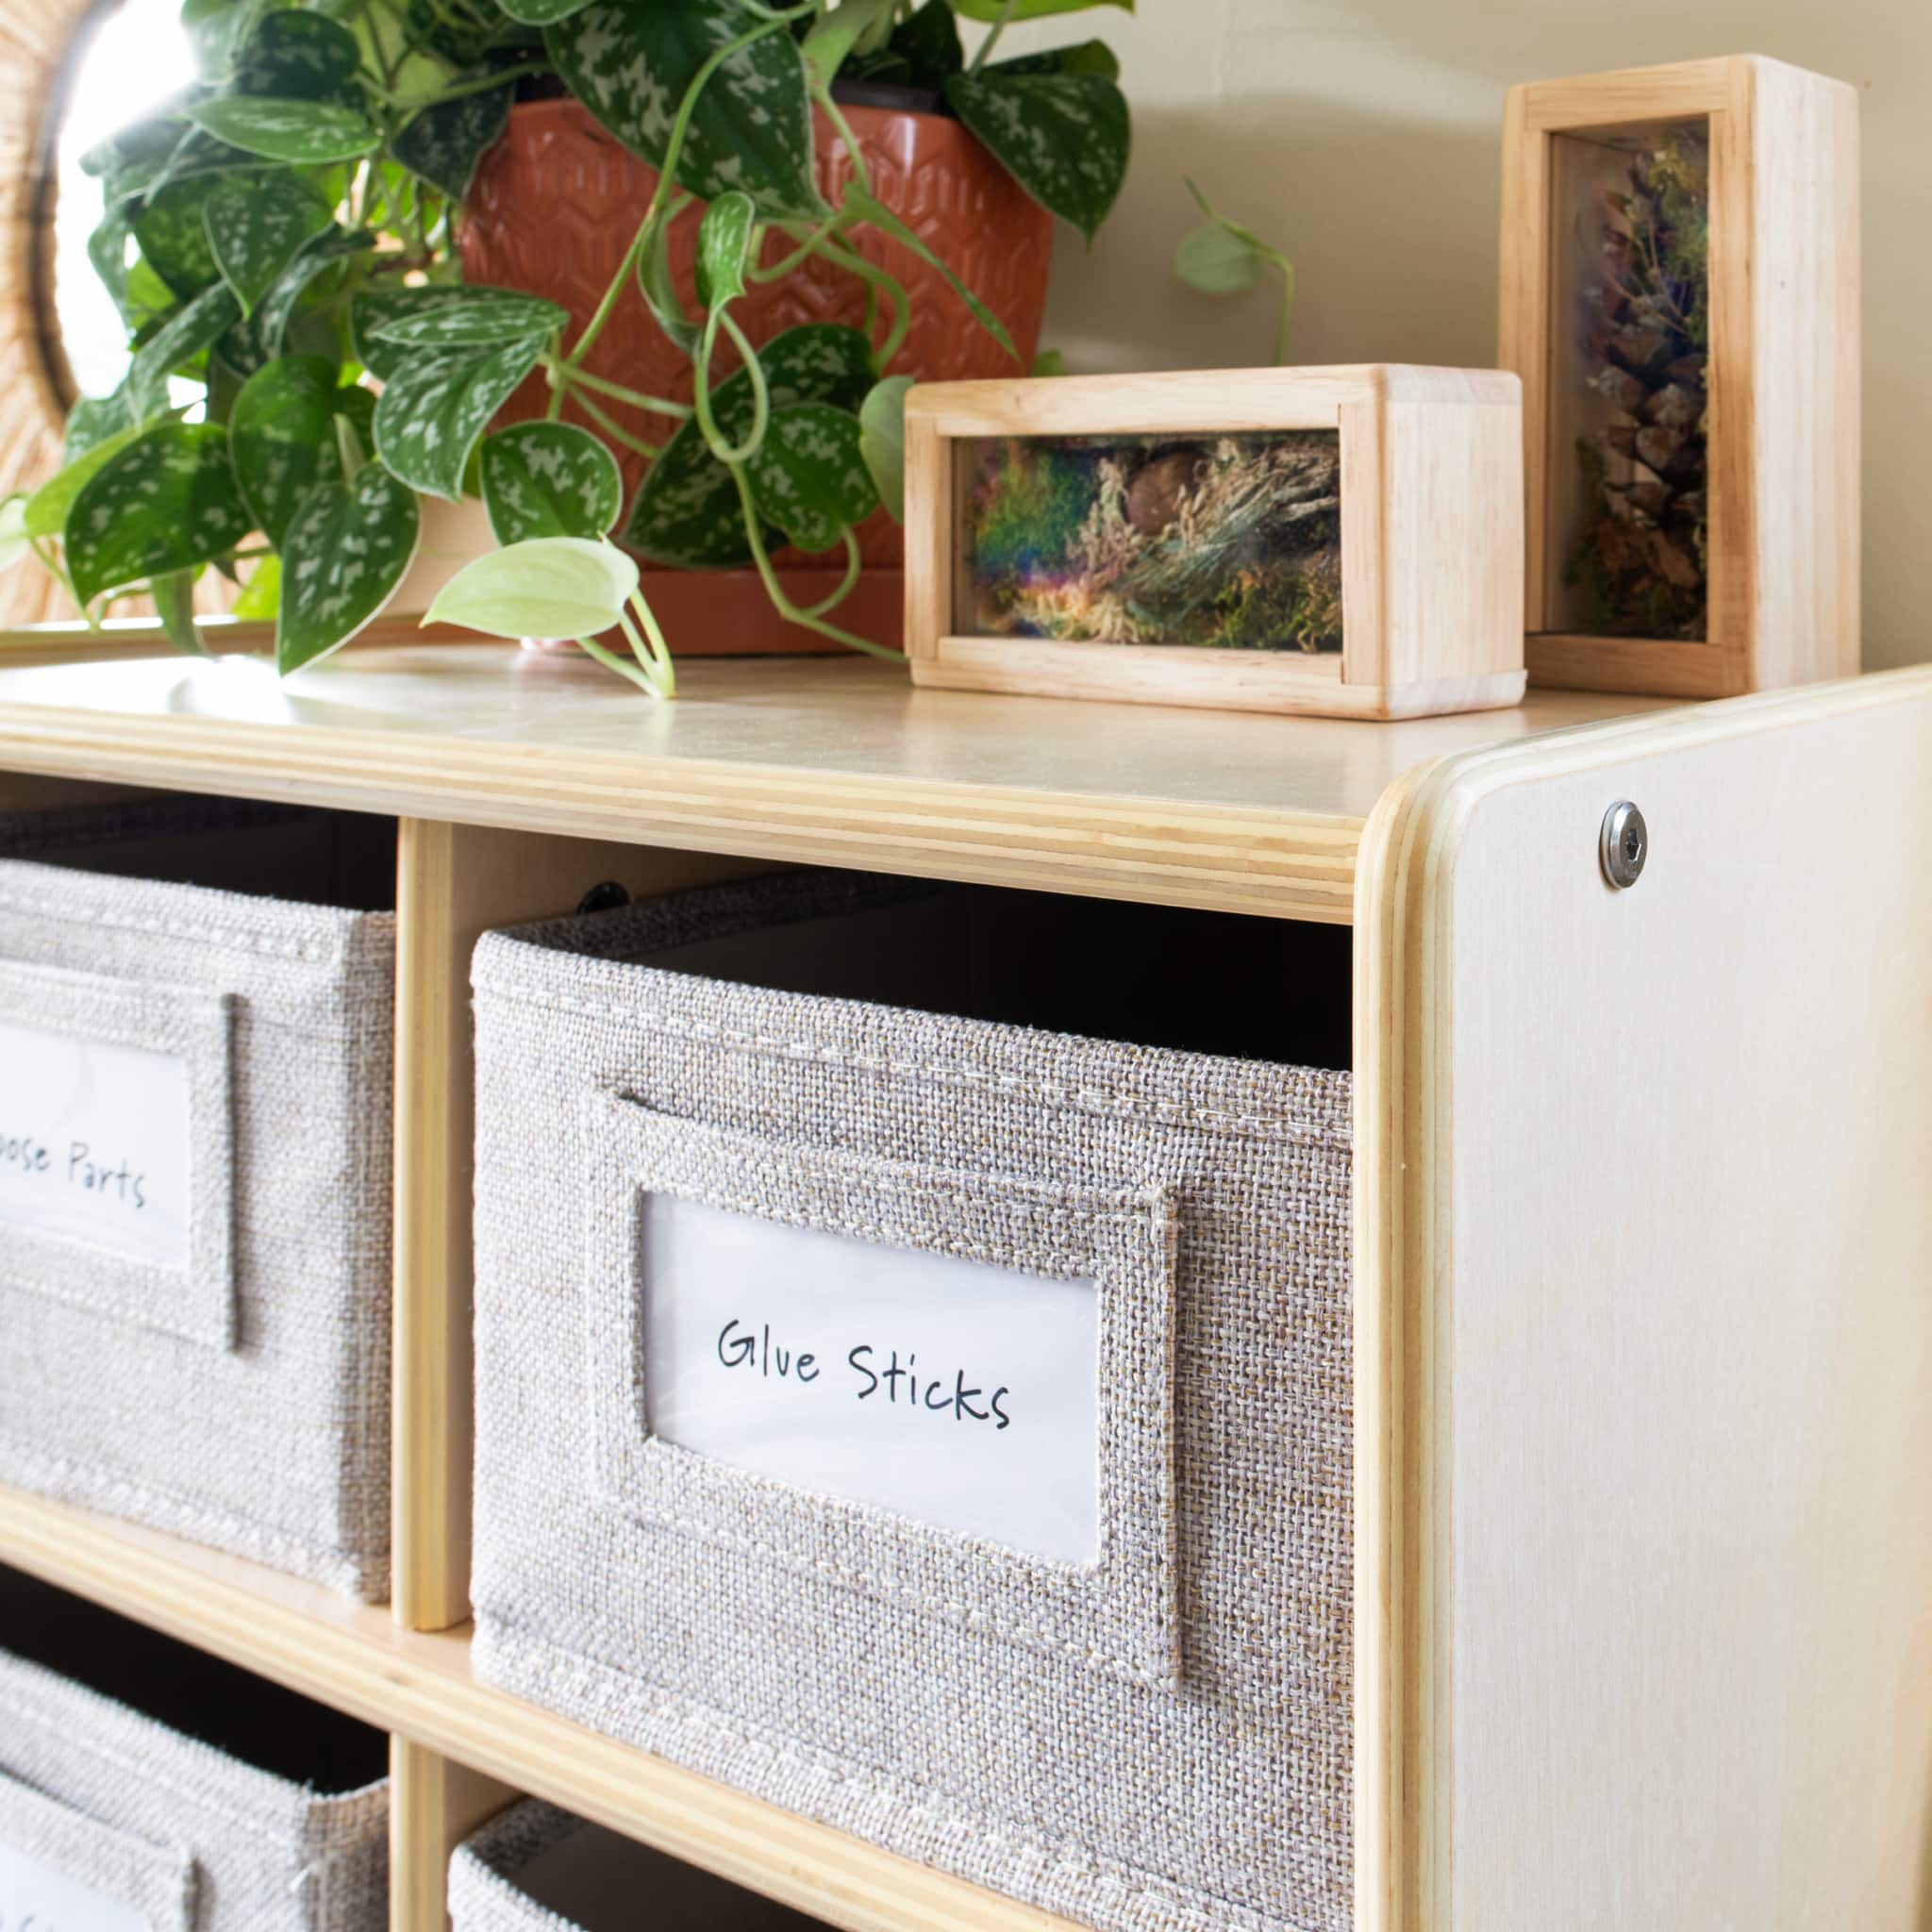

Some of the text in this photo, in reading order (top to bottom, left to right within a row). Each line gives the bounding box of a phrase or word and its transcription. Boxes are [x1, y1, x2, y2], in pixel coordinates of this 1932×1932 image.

[69, 1141, 144, 1208] Parts
[718, 1319, 1009, 1429] Glue Sticks
